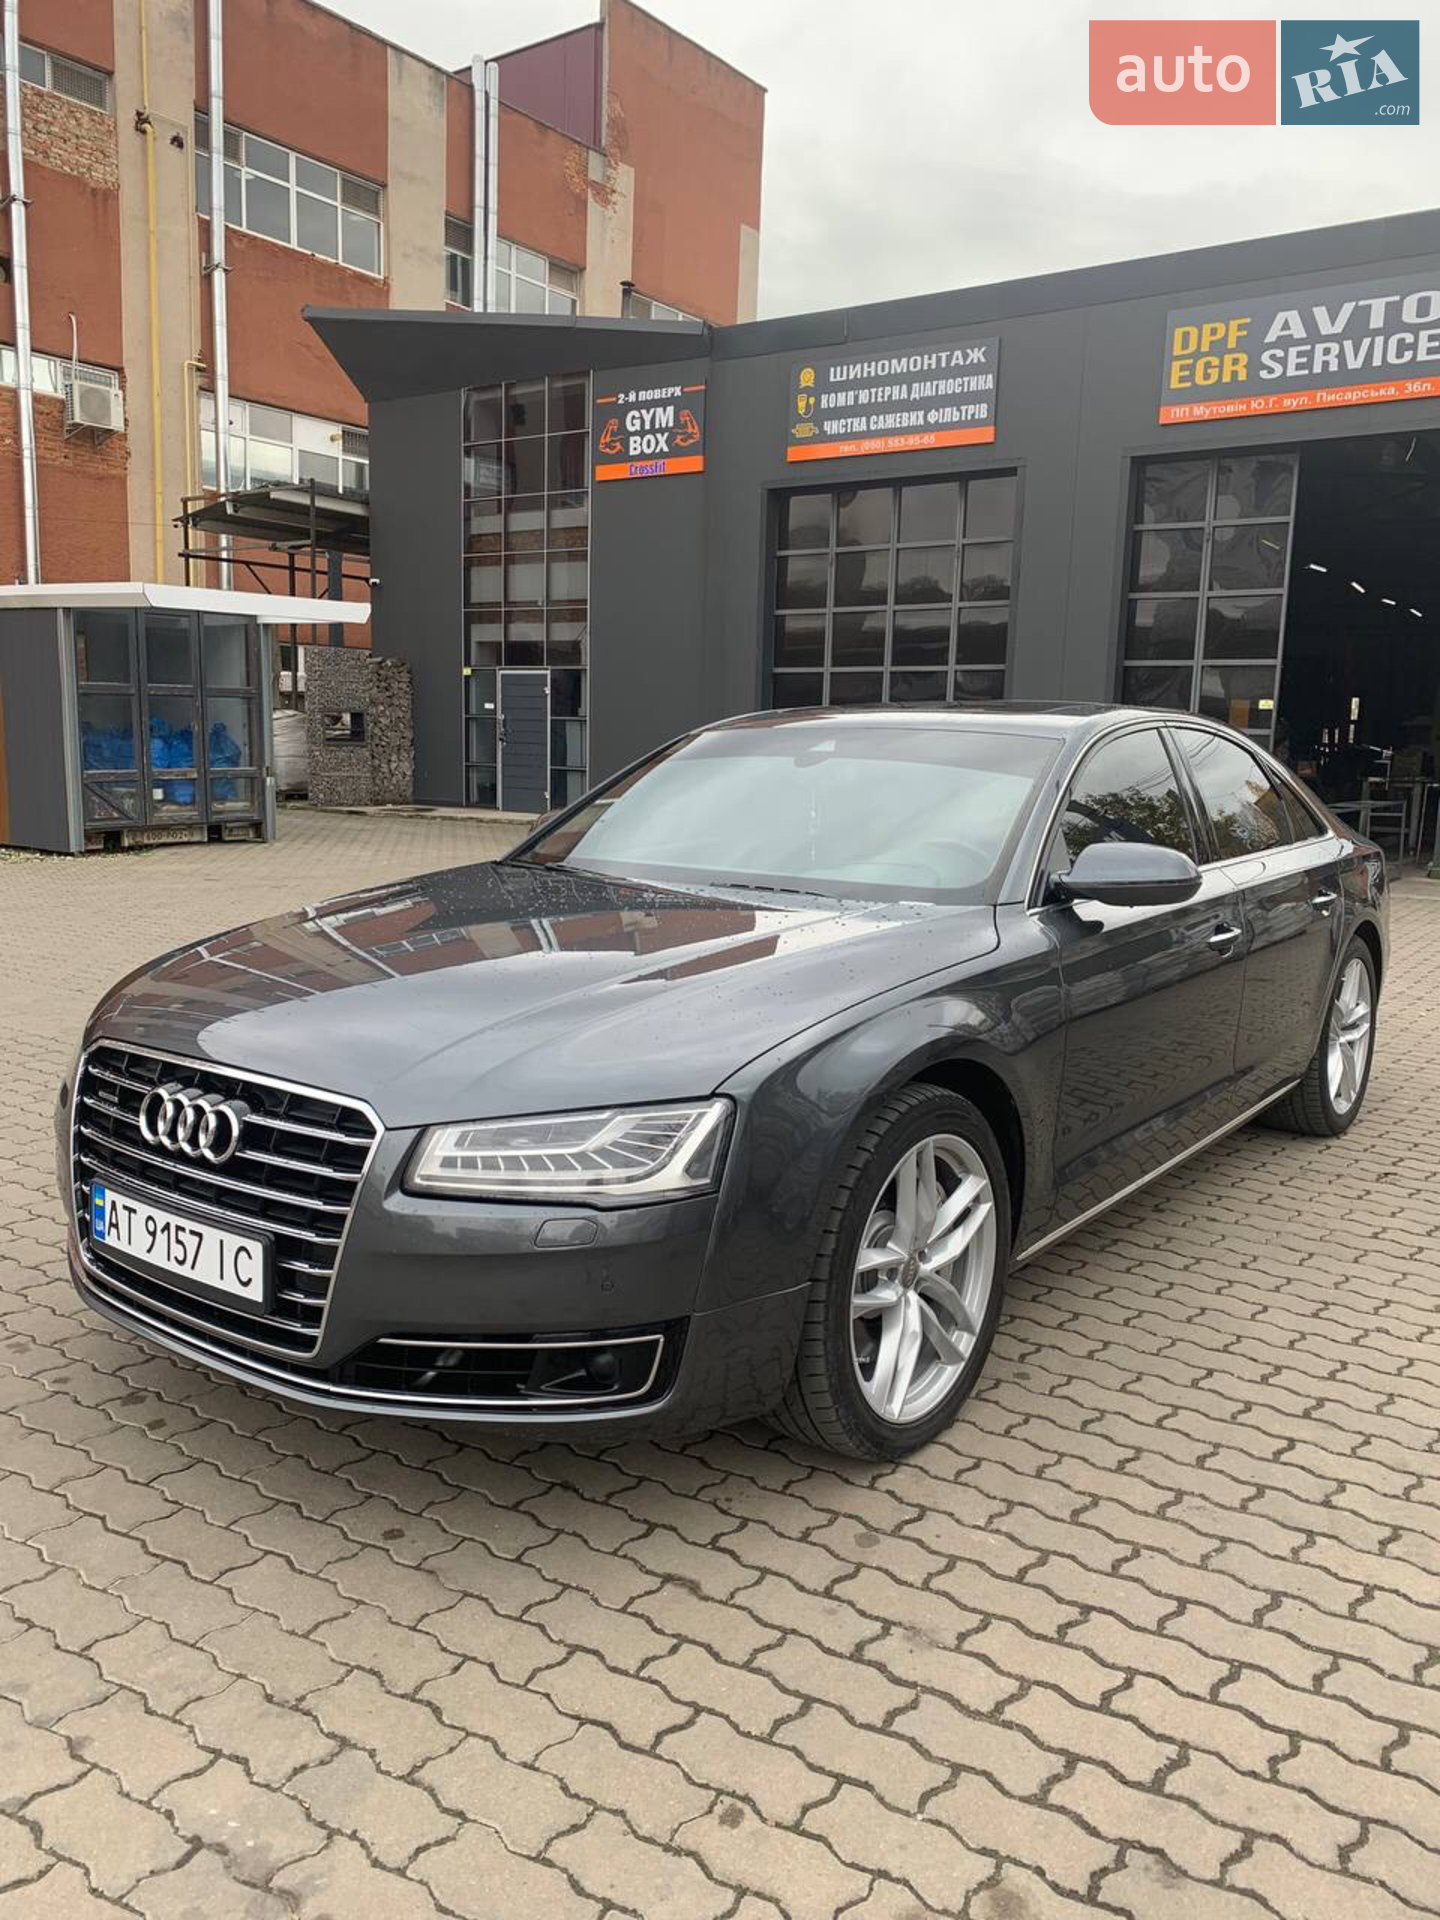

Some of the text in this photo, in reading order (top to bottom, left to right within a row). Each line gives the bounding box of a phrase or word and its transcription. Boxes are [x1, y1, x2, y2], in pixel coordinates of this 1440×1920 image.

[1172, 290, 1440, 357] DPF AVTO
[828, 346, 987, 382] ШИНОМОНТАЖ
[1169, 328, 1440, 390] EGR SERVICE
[617, 385, 682, 405] 2-Й ПОВЕРХ
[821, 373, 994, 409] КОМП'ЮТЕРНА ДІАГНОСТИКА
[1170, 407, 1189, 419] ПП
[1282, 394, 1312, 409] вул.
[625, 405, 674, 433] GYM
[823, 403, 989, 436] ЧИСТКА САЖЕВИХ ФІЛЬТРІВ
[629, 431, 670, 457] BOX
[107, 1199, 253, 1288] AT 9157 IC
